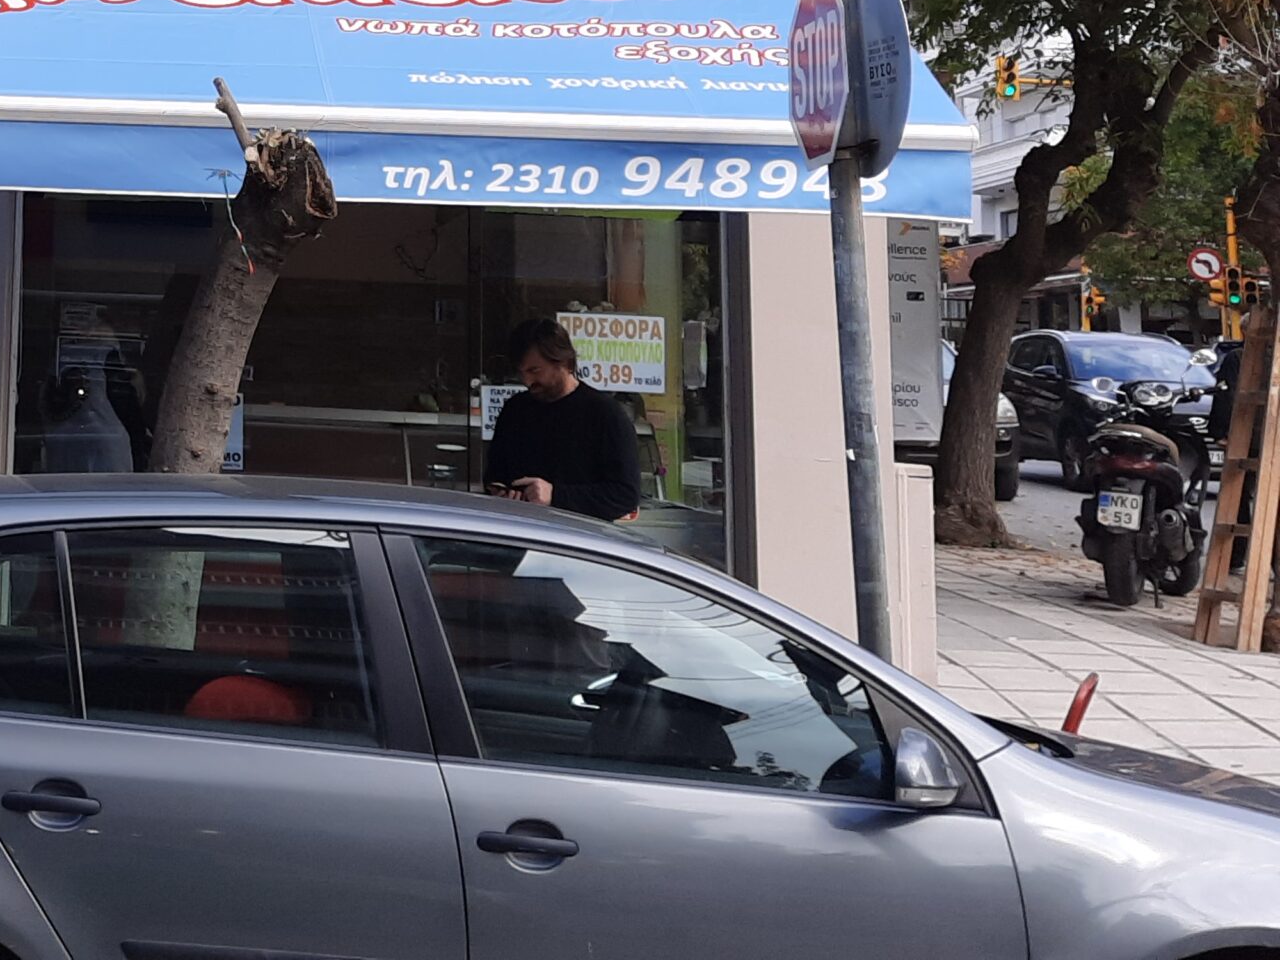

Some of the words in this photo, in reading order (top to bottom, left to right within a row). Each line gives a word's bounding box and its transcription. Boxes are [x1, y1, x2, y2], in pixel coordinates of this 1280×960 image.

[335, 16, 481, 38] νωπά
[491, 17, 780, 41] κοτόπουλα
[614, 40, 789, 65] εξοχής
[793, 9, 839, 120] STOP
[407, 70, 532, 87] πώληση
[545, 73, 688, 91] χονδρική
[381, 154, 473, 194] τηλ:
[486, 161, 600, 196] 2310
[592, 363, 633, 387] 3,89
